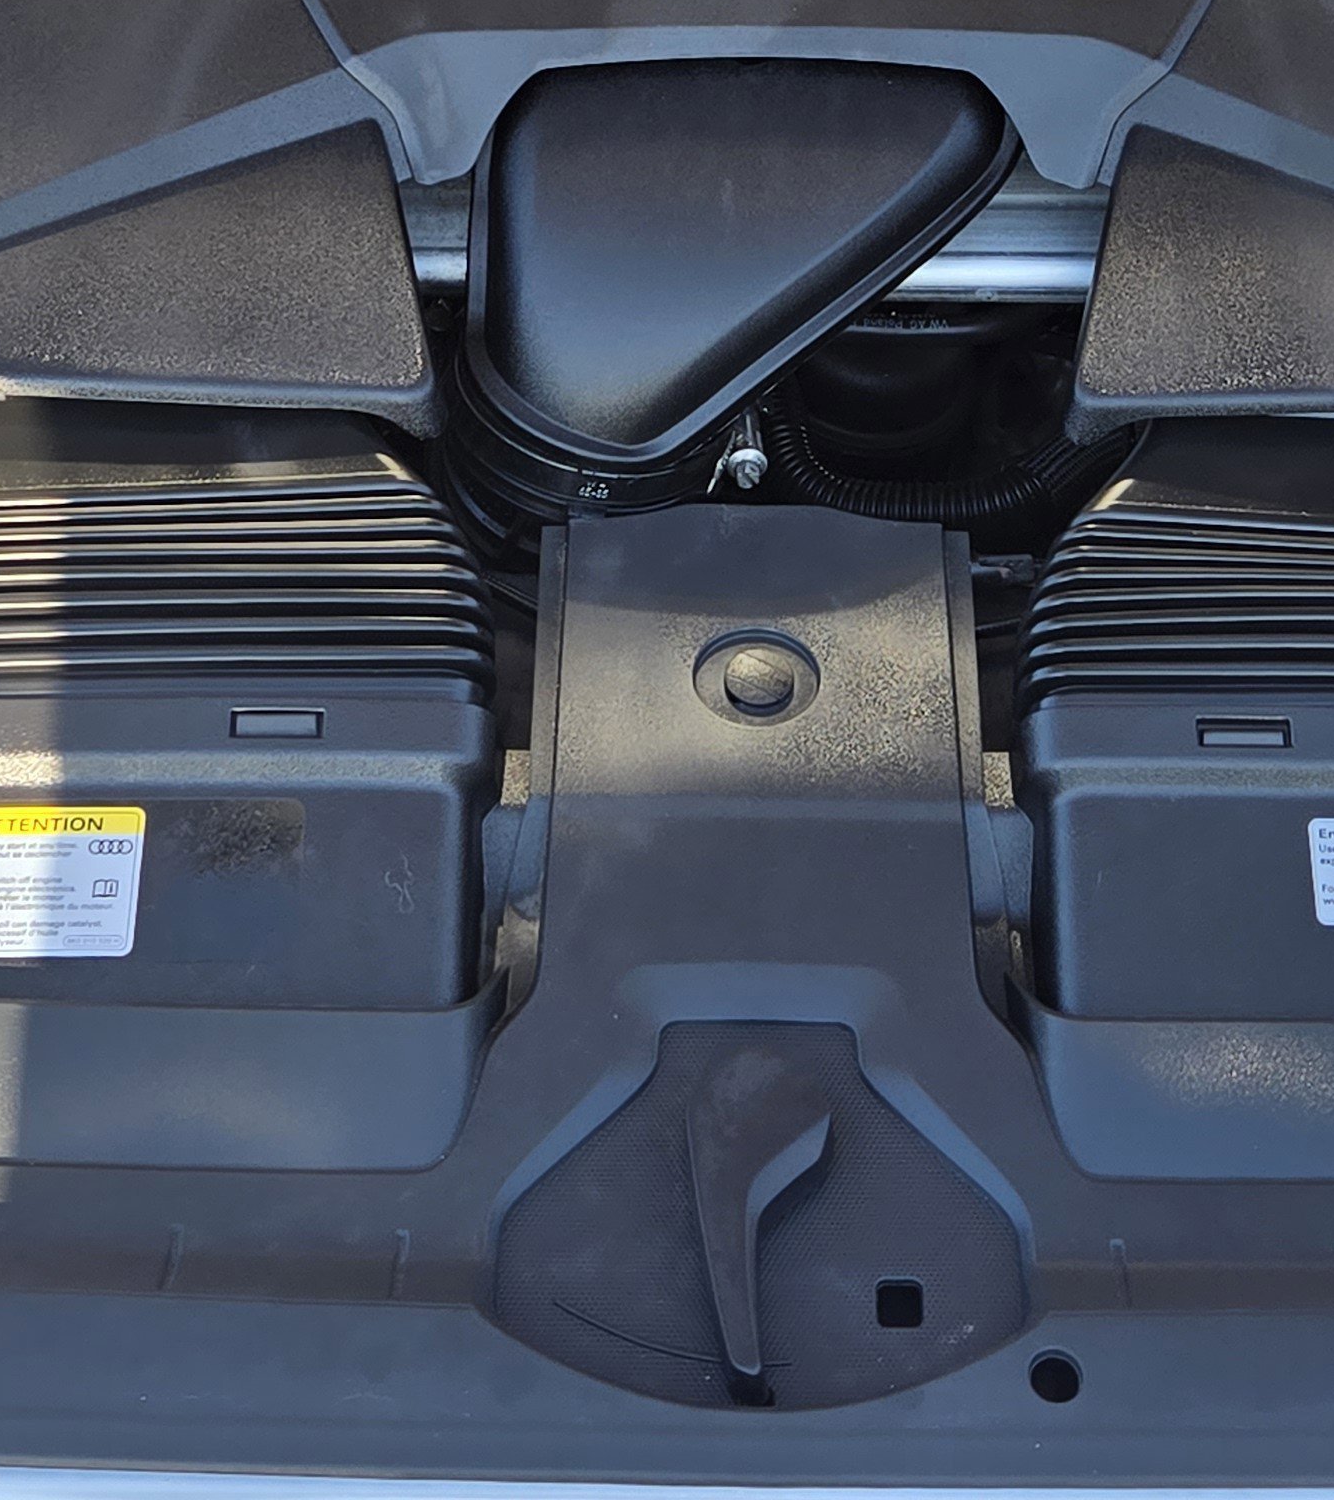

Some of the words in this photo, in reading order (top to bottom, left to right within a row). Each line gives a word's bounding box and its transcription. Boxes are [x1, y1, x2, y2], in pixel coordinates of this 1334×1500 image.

[32, 877, 63, 886] engine
[0, 920, 10, 928] oil
[29, 921, 65, 929] damage
